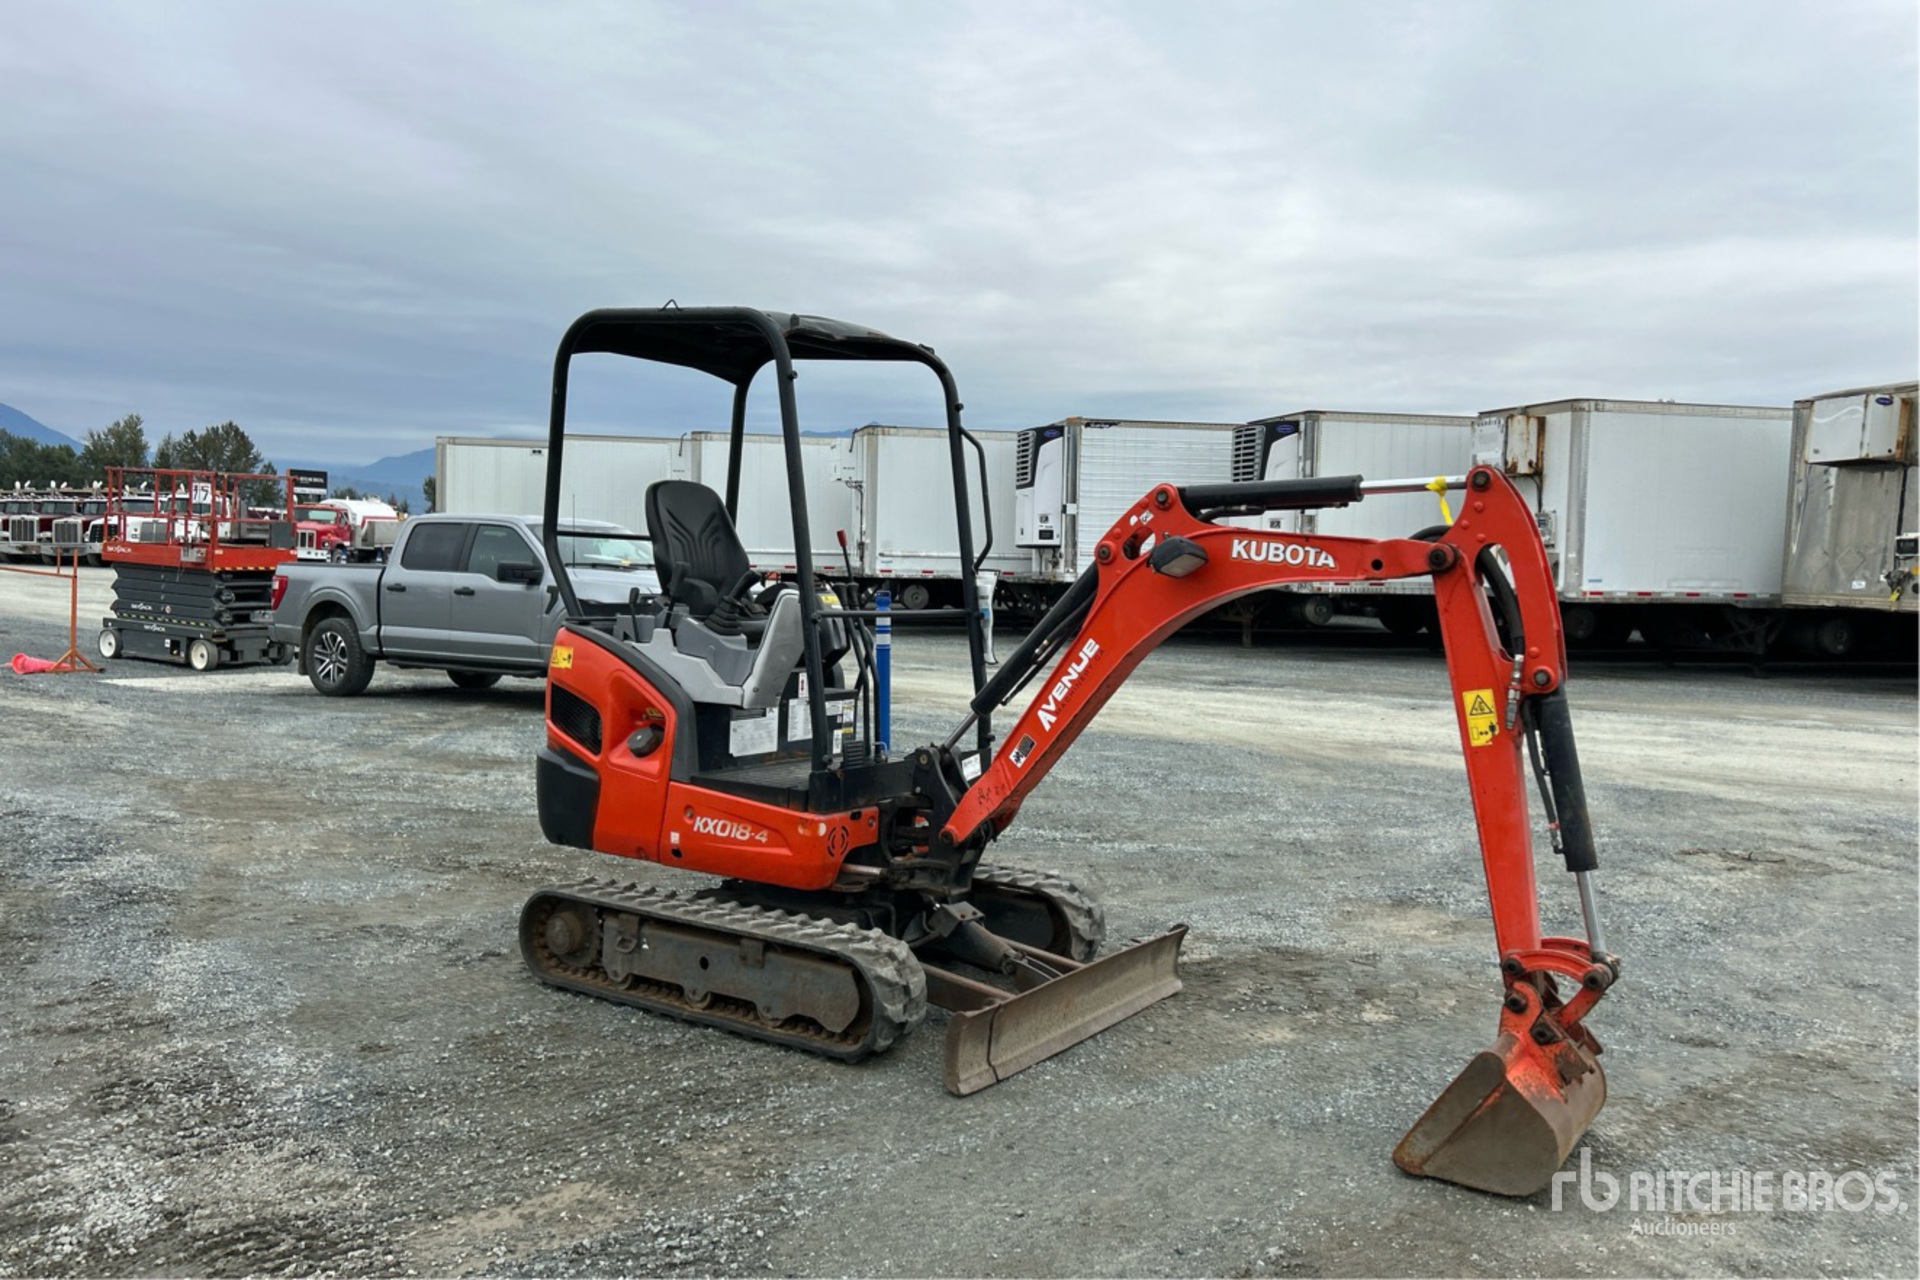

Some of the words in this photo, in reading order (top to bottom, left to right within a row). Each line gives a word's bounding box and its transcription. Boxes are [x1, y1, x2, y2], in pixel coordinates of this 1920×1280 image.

[1231, 539, 1336, 568] KUBOTA
[1037, 638, 1100, 732] AVENUE
[693, 816, 768, 843] KX018-4
